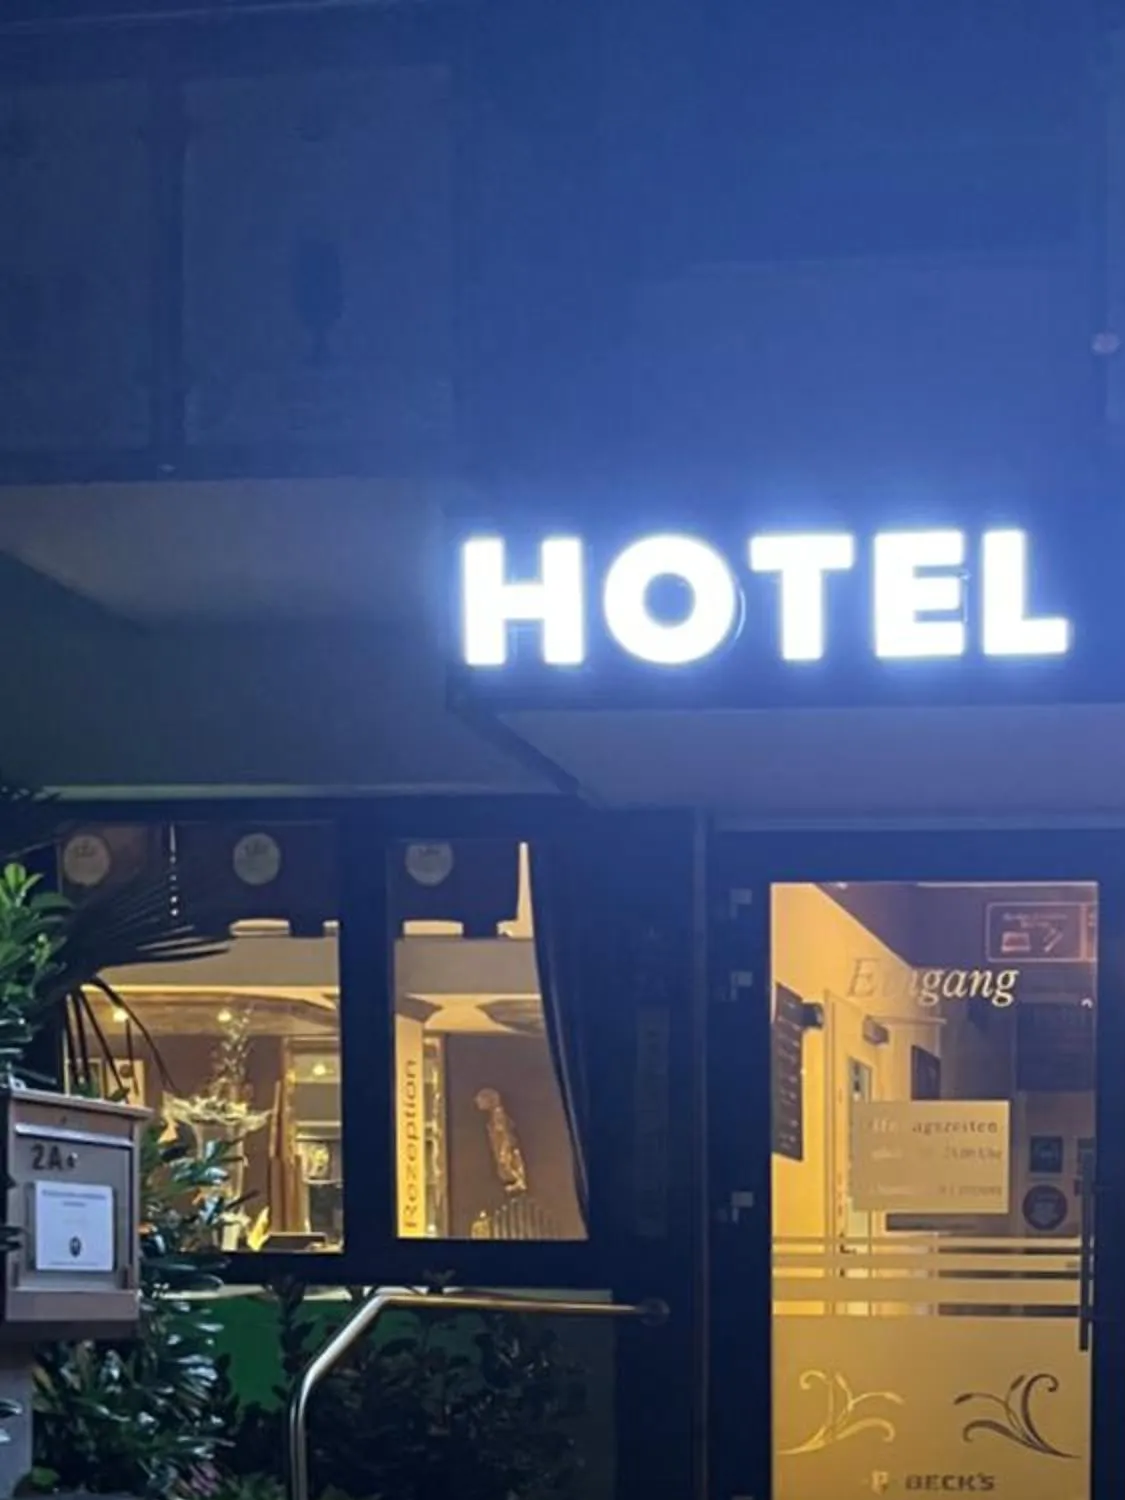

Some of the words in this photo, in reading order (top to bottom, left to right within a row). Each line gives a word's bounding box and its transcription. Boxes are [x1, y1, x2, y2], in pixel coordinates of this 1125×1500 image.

[464, 530, 1067, 665] HOTEL
[847, 957, 1019, 1007] Engang
[402, 1059, 419, 1229] Rezeption
[904, 1472, 997, 1491] BECK'S
